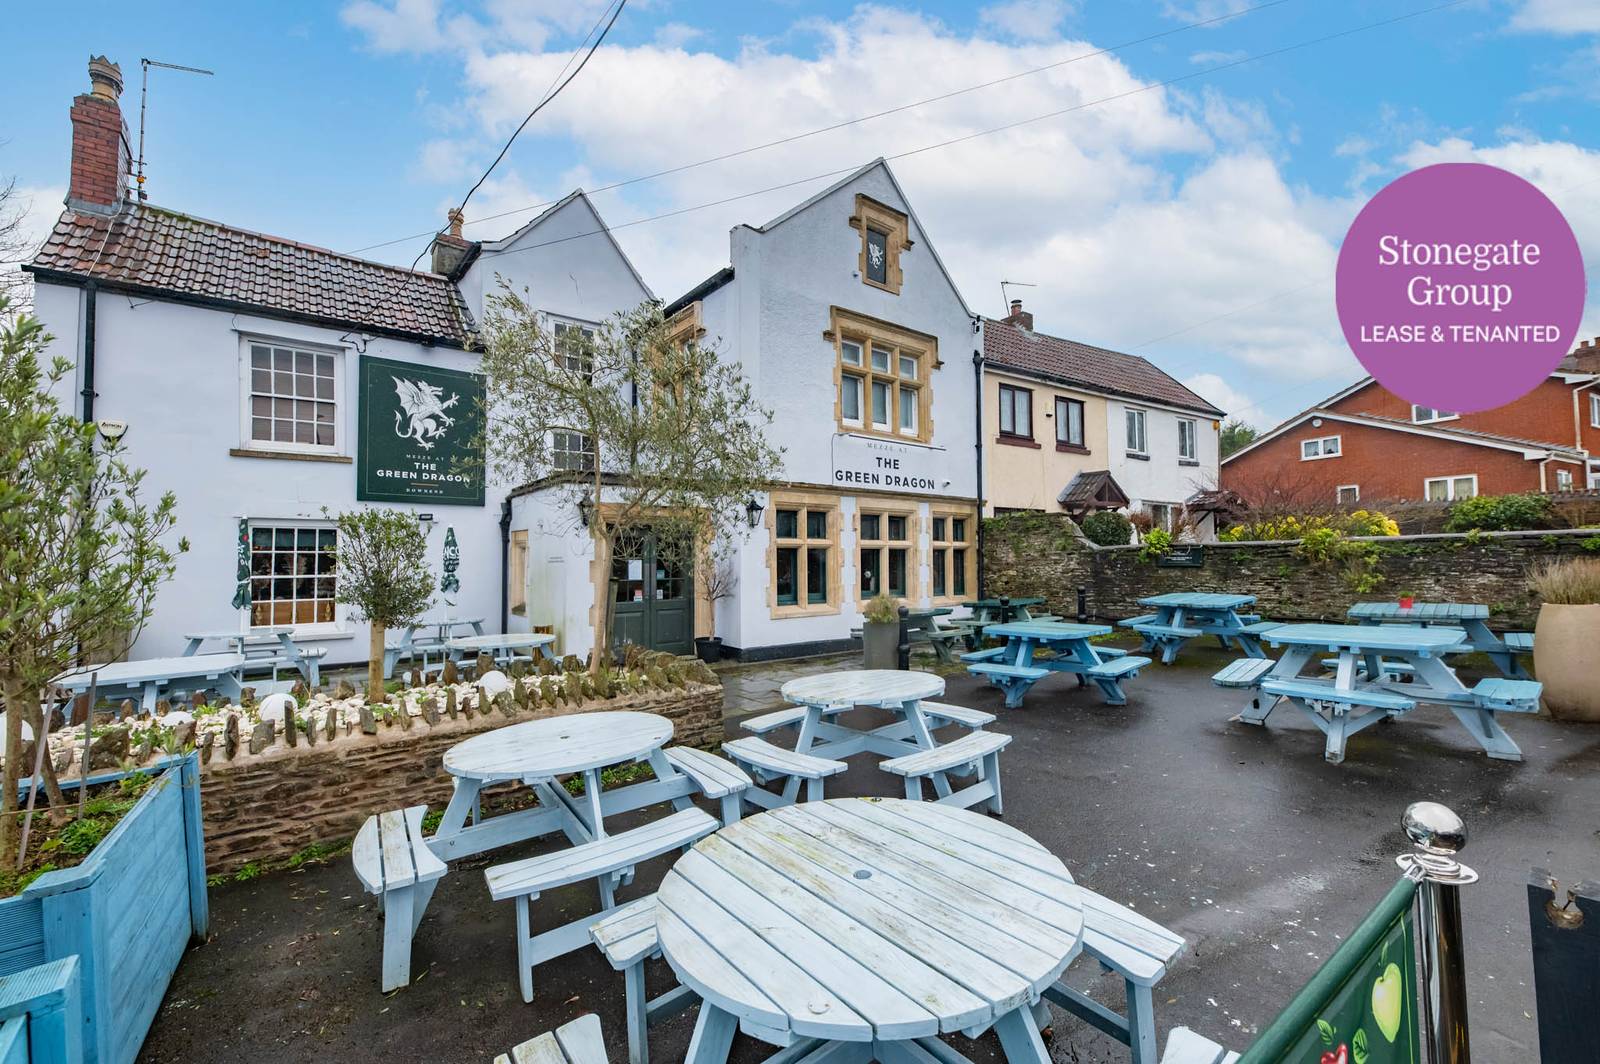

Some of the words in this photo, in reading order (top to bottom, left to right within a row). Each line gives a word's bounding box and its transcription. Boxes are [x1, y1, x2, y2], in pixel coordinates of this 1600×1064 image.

[414, 462, 437, 471] THE
[876, 457, 900, 470] THE
[376, 469, 417, 480] GREEN
[422, 472, 470, 483] DRAGON
[835, 470, 880, 485] GREEN
[885, 475, 935, 490] DRAGON
